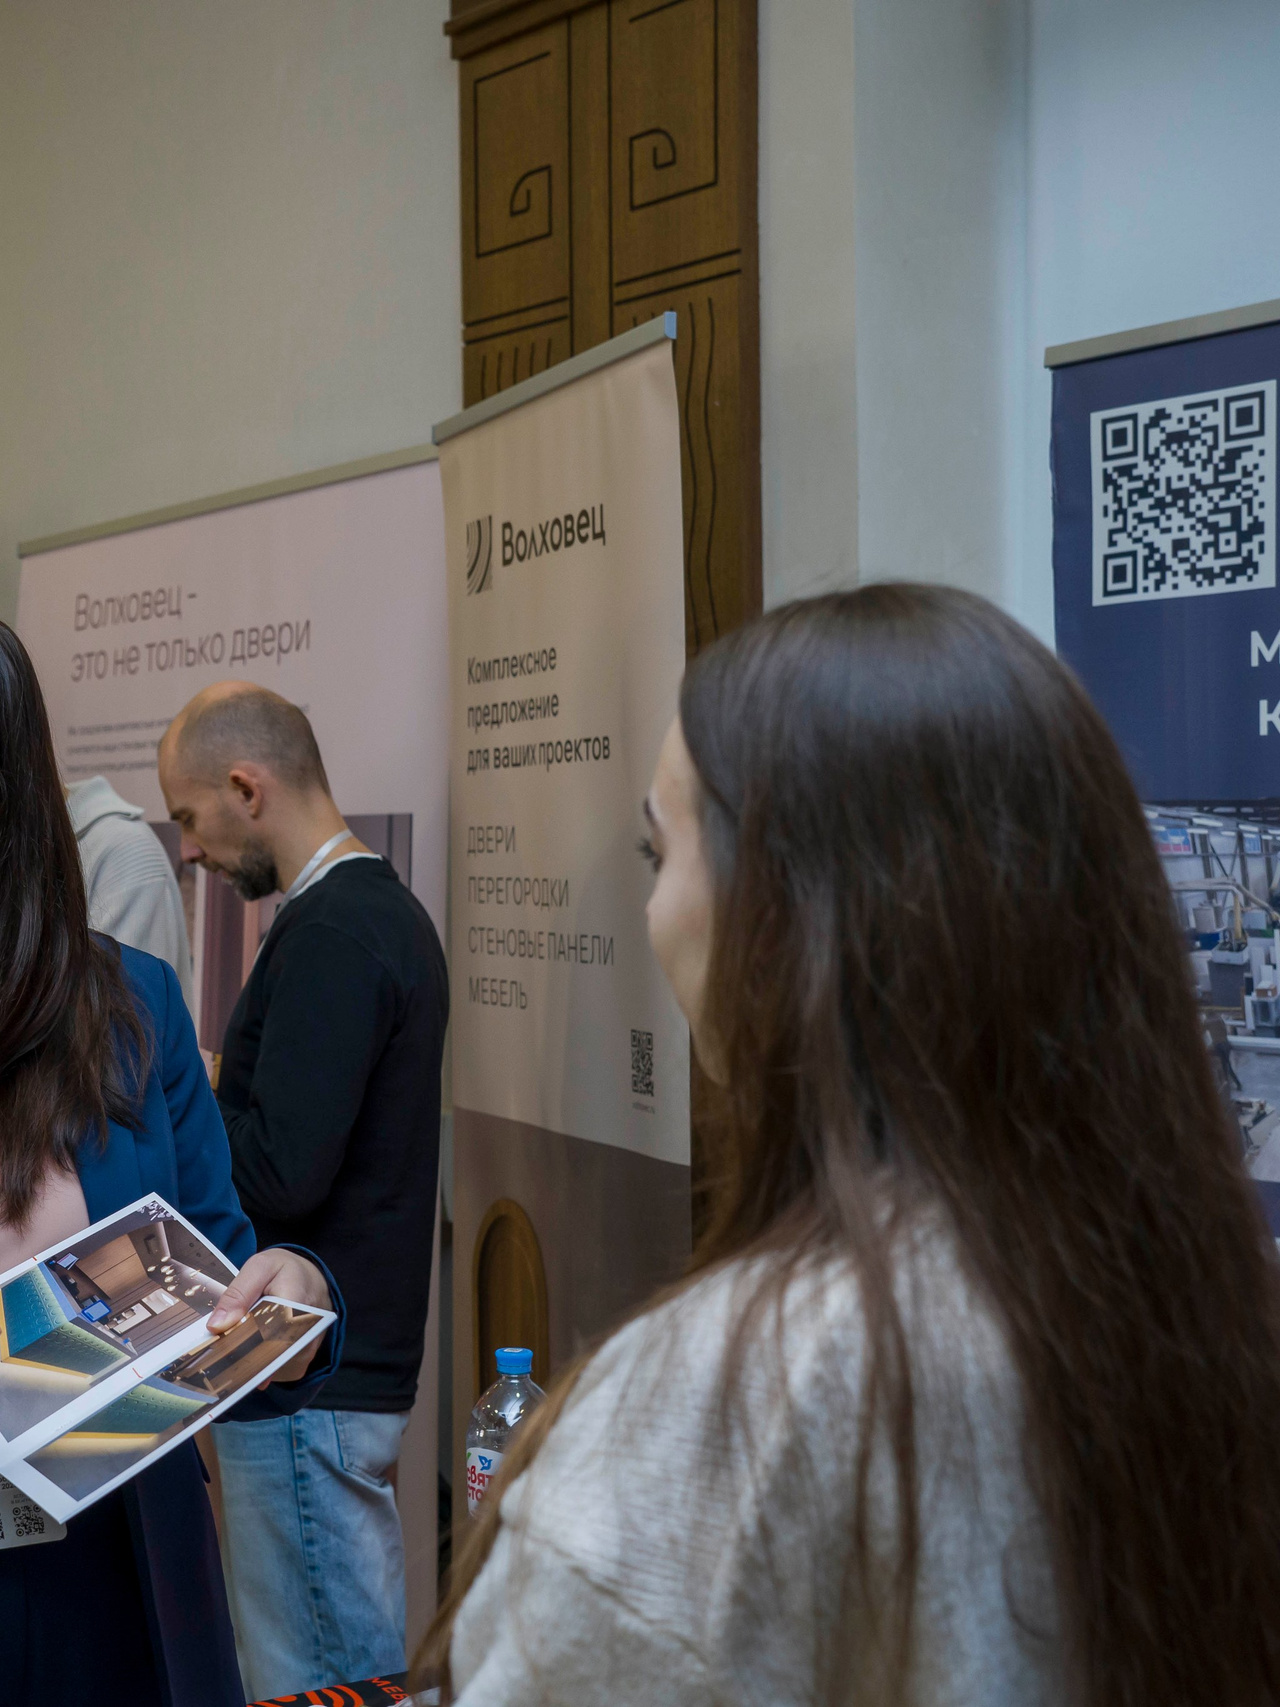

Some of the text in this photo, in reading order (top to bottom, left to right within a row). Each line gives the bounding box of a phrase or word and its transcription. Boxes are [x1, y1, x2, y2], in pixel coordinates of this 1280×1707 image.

[502, 503, 606, 567] Волховец
[74, 585, 182, 632] Волховец
[70, 619, 311, 683] это не только двери
[467, 647, 557, 686] Комплексное
[467, 694, 559, 734] предложение
[467, 735, 610, 775] для ваших проектов
[467, 826, 515, 857] ДВЕРИ
[468, 876, 569, 911] ПЕРЕГОРОДКИ
[468, 926, 614, 966] СТЕНОВЫЕ ПАНЕЛИ
[469, 977, 528, 1010] МЕБЕЛЬ
